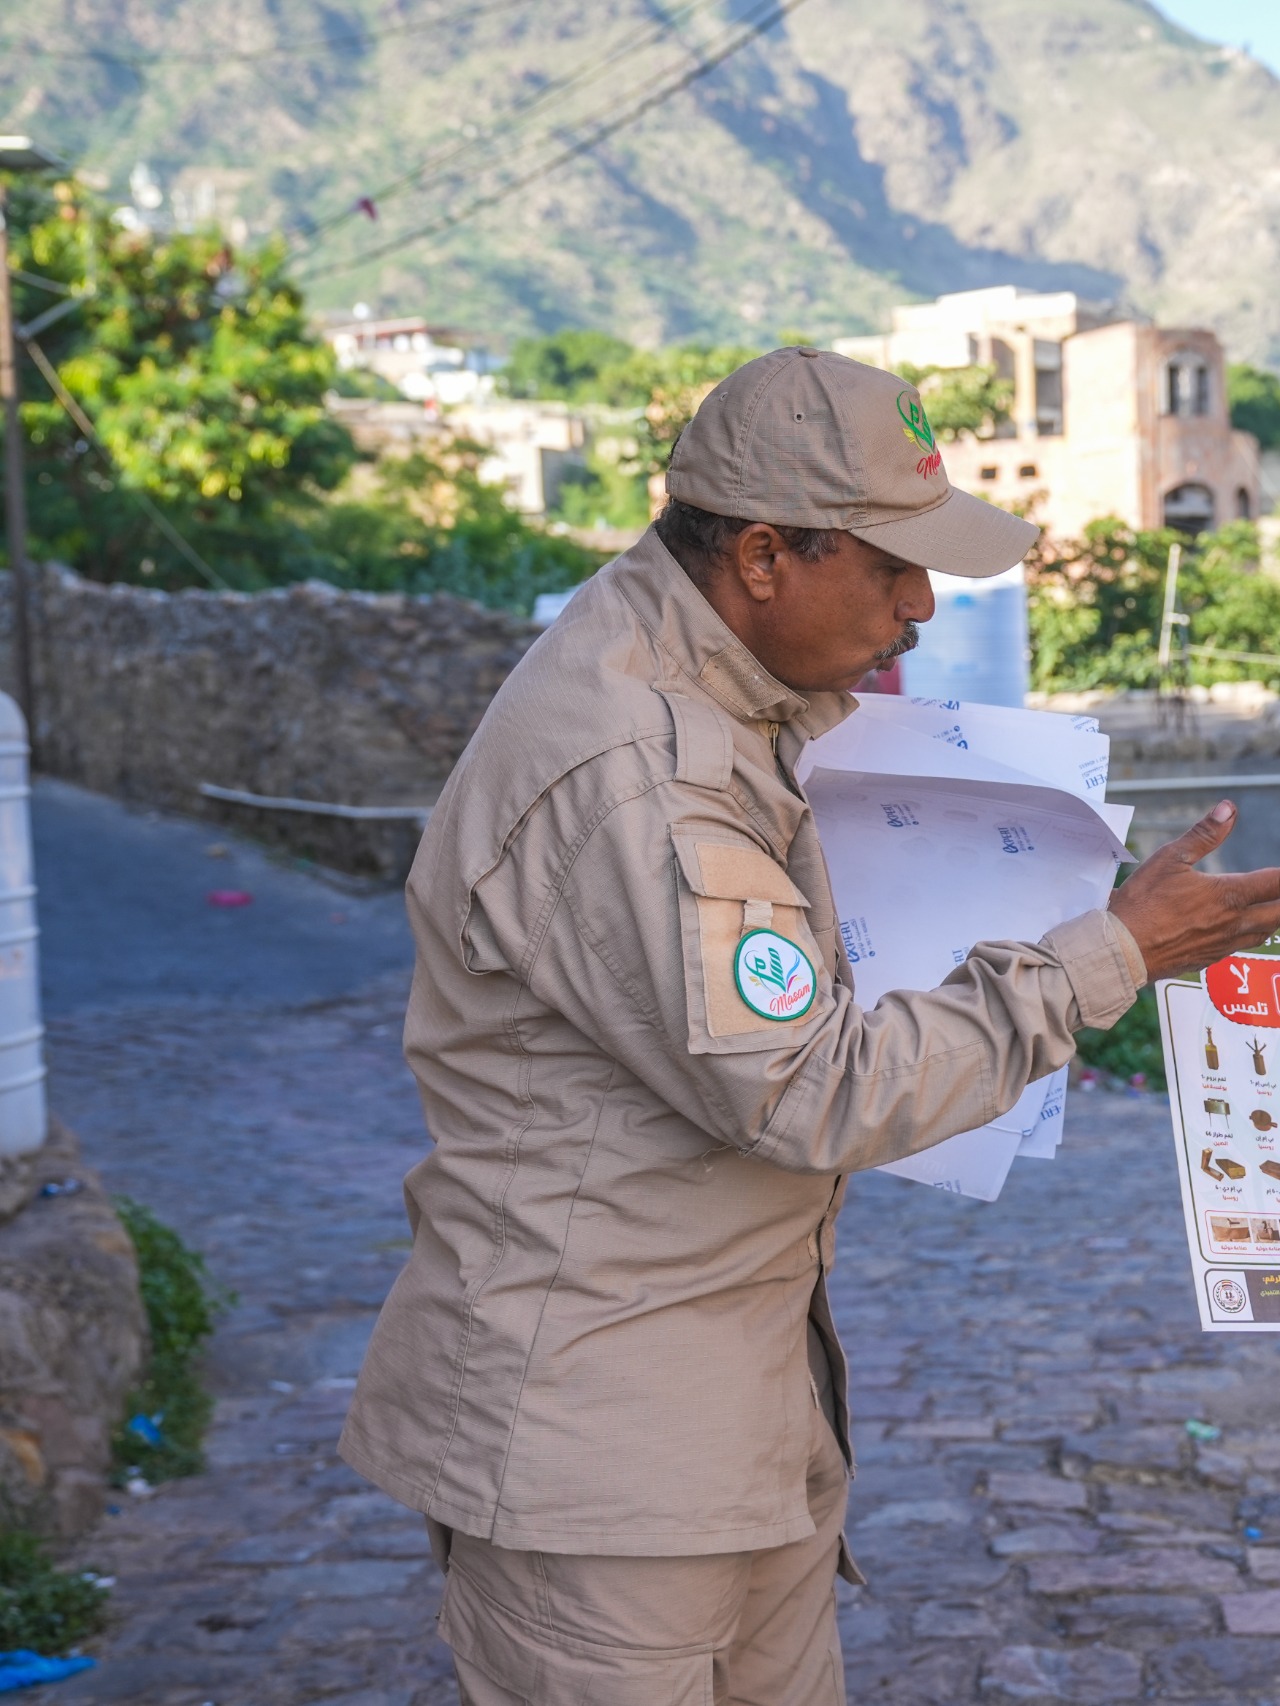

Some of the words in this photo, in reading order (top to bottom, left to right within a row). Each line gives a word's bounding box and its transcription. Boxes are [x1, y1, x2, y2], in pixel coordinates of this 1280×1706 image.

[1229, 963, 1250, 995] لا
[769, 984, 811, 1015] Masam
[1223, 1001, 1269, 1016] تلمس
